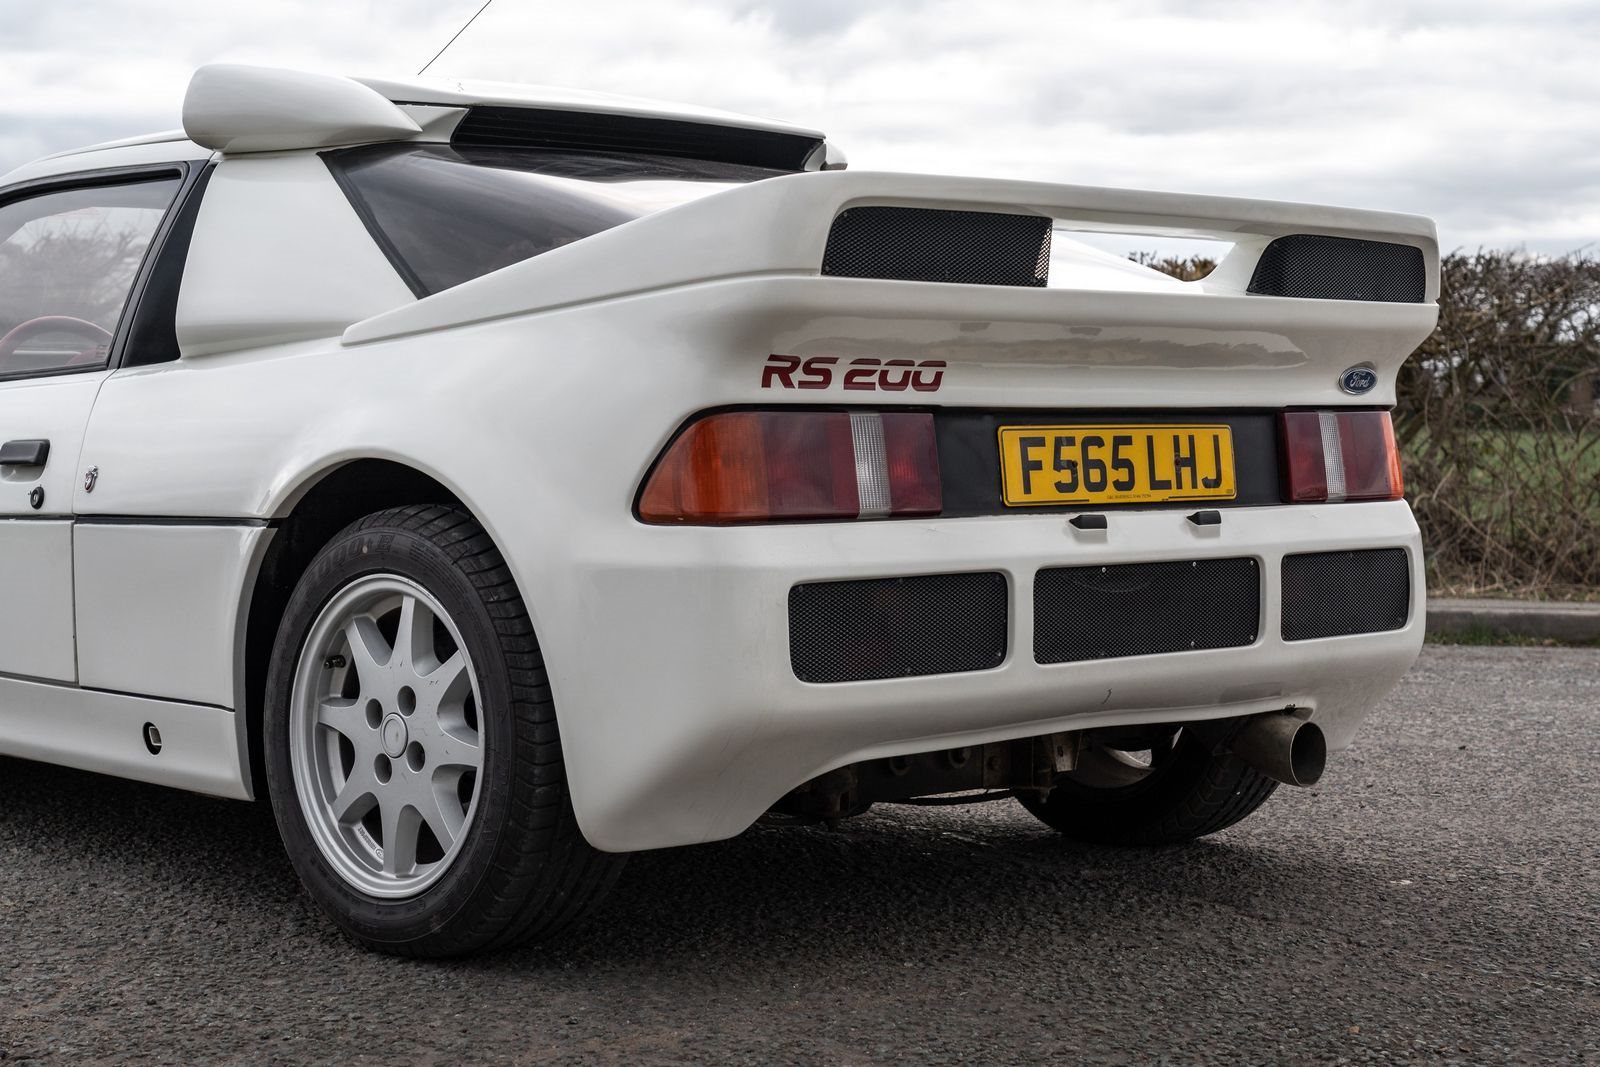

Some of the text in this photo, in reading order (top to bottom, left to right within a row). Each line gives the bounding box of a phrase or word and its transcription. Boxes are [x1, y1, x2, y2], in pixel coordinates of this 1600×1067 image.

[761, 354, 947, 392] RS 200
[1350, 371, 1371, 388] Ford
[1019, 435, 1222, 494] F565 LHJ
